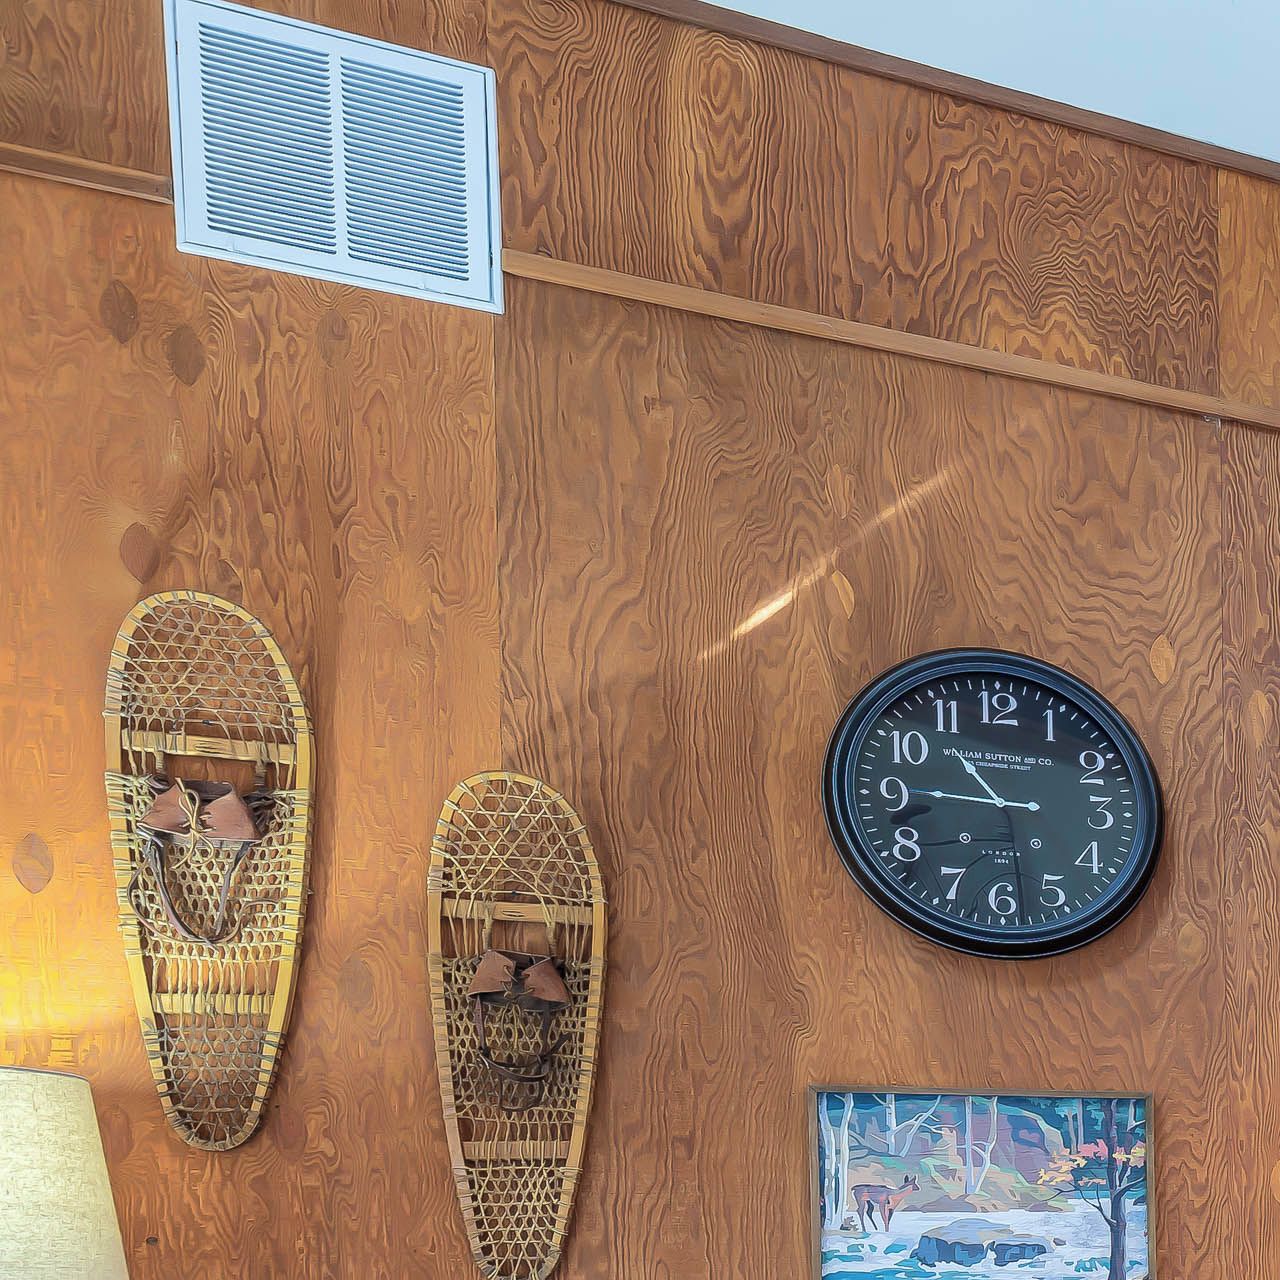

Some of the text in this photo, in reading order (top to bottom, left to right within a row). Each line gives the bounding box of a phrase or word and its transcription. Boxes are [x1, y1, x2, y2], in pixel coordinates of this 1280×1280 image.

[932, 699, 960, 733] 11
[978, 690, 1018, 726] 12
[1042, 709, 1056, 741] 1
[888, 730, 929, 765] 10
[984, 752, 1021, 762] SUTTON
[1038, 758, 1055, 766] CO.
[1079, 750, 1105, 785] 2
[879, 776, 909, 811] 9
[1087, 795, 1114, 829] 3
[892, 826, 921, 861] 8
[1074, 841, 1104, 874] 4
[940, 866, 966, 900] 7
[988, 882, 1017, 915] 6
[1039, 873, 1066, 907] 5
